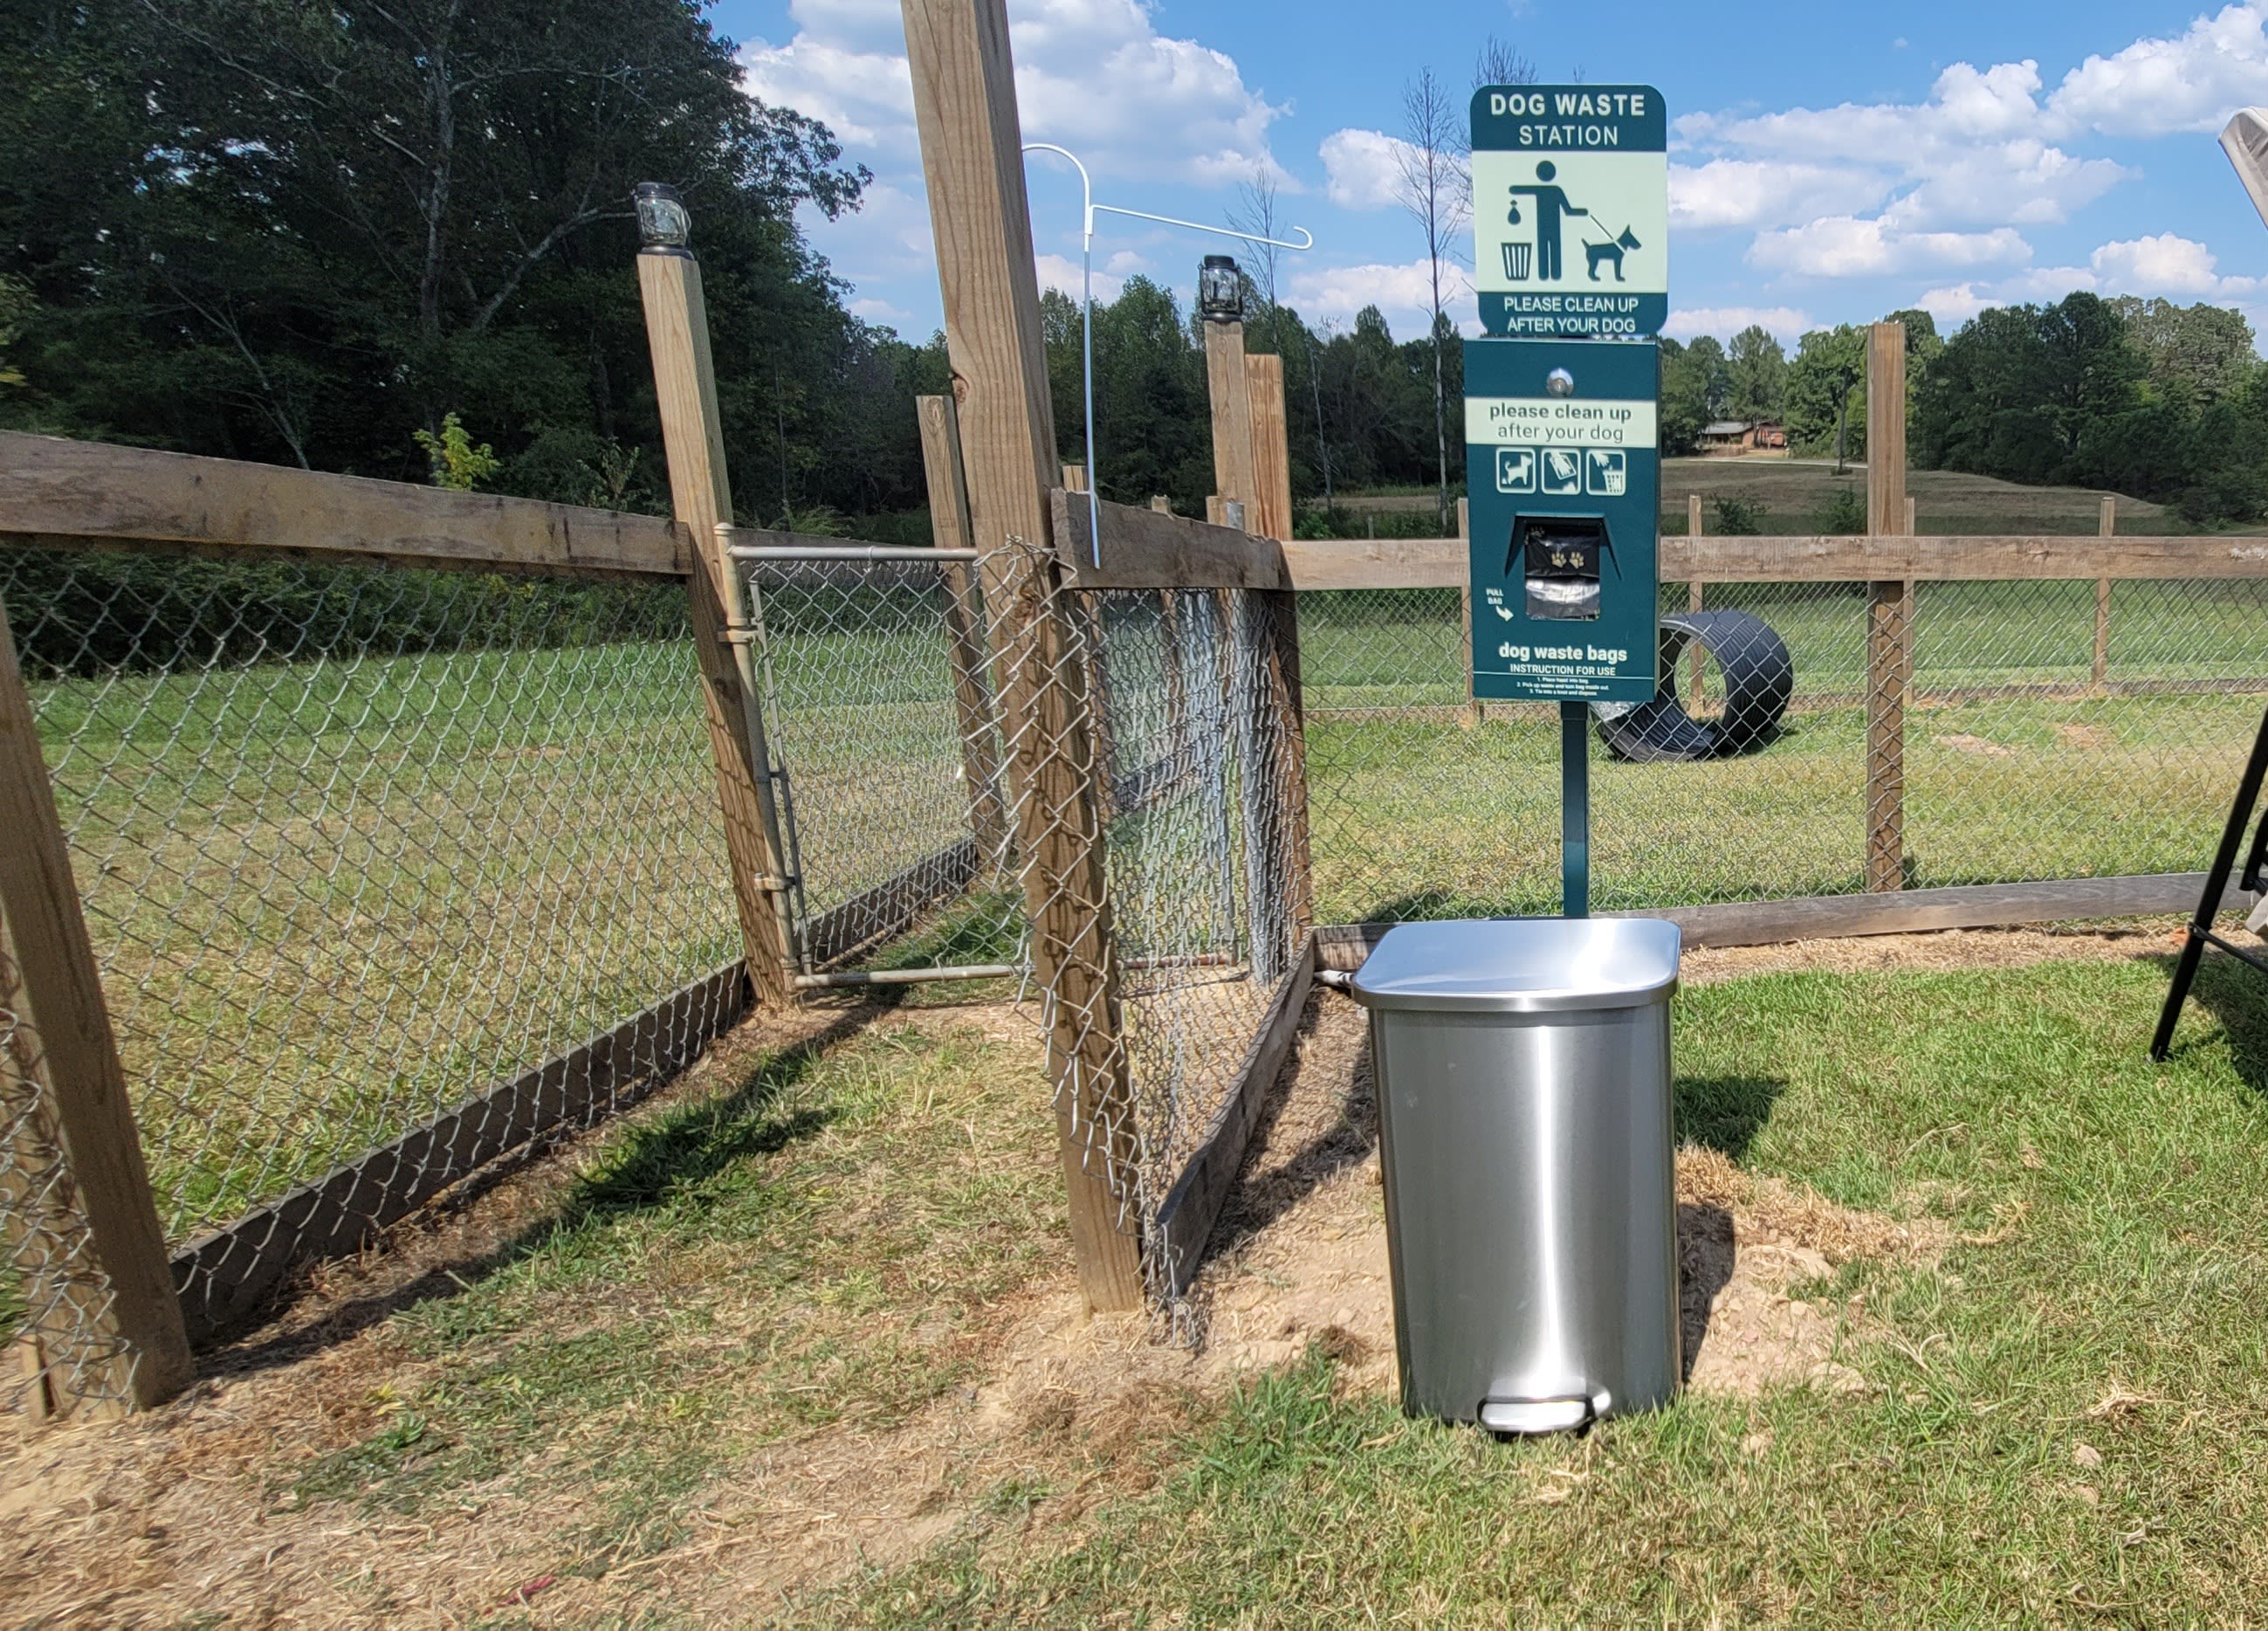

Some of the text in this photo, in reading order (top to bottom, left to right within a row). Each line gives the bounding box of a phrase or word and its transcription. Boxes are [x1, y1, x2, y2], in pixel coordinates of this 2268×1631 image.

[1490, 93, 1646, 117] DOG WASTE
[1519, 125, 1619, 147] STATION
[1503, 296, 1639, 313] PLEASE CLEAN UP
[1507, 317, 1636, 334] AFTER YOUR DOG
[1489, 403, 1632, 423] please clean up
[1498, 423, 1624, 444] after your dog
[1486, 588, 1504, 596] PULL
[1499, 642, 1628, 664] dog waste bags
[1509, 664, 1616, 676] INSTRUCTION FOR USE
